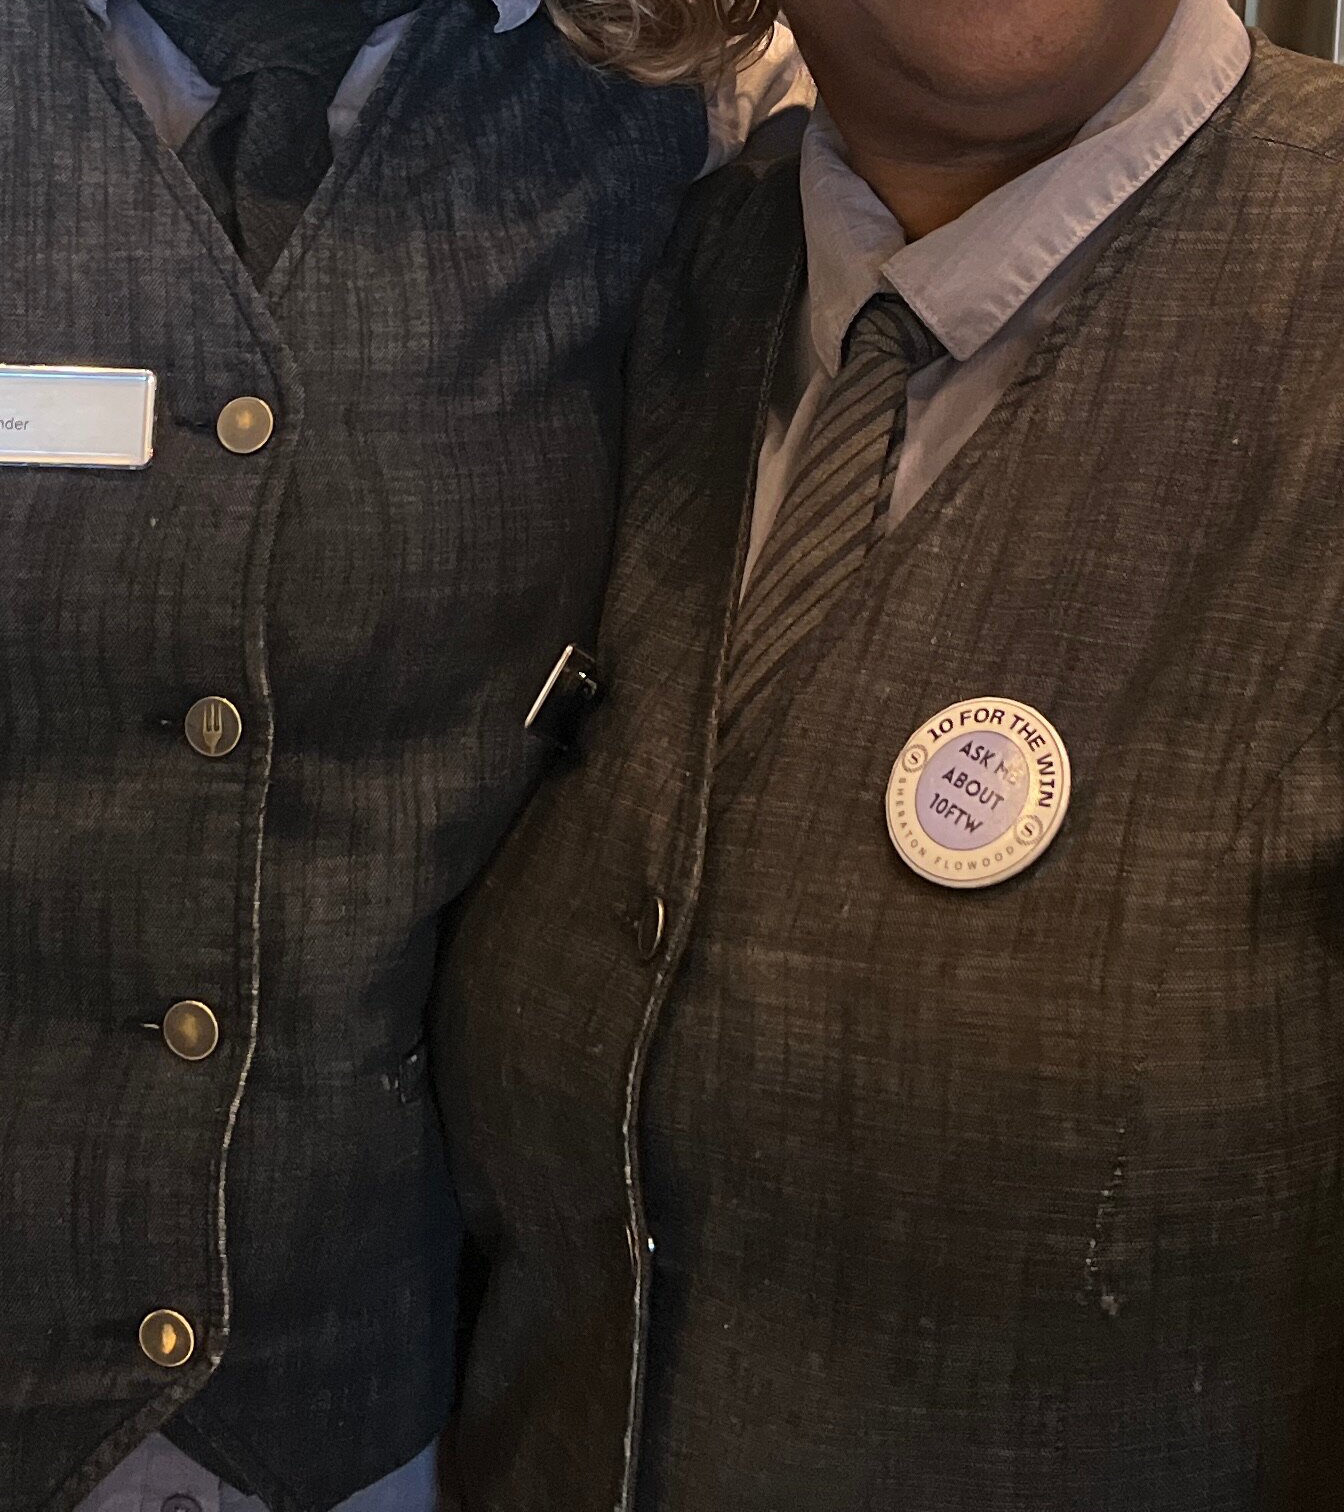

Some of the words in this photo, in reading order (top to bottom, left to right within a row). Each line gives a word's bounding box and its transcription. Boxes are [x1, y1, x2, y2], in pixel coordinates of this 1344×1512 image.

[927, 717, 954, 743] 10
[959, 707, 1006, 727] FOR
[1008, 714, 1047, 753] THE
[1036, 752, 1056, 808] WIN
[958, 740, 996, 769] ASK
[940, 766, 1005, 811] ABOUT
[894, 777, 927, 857] SHERATON
[933, 845, 1015, 870] FLOWOOD
[929, 792, 984, 834] 10FTW
